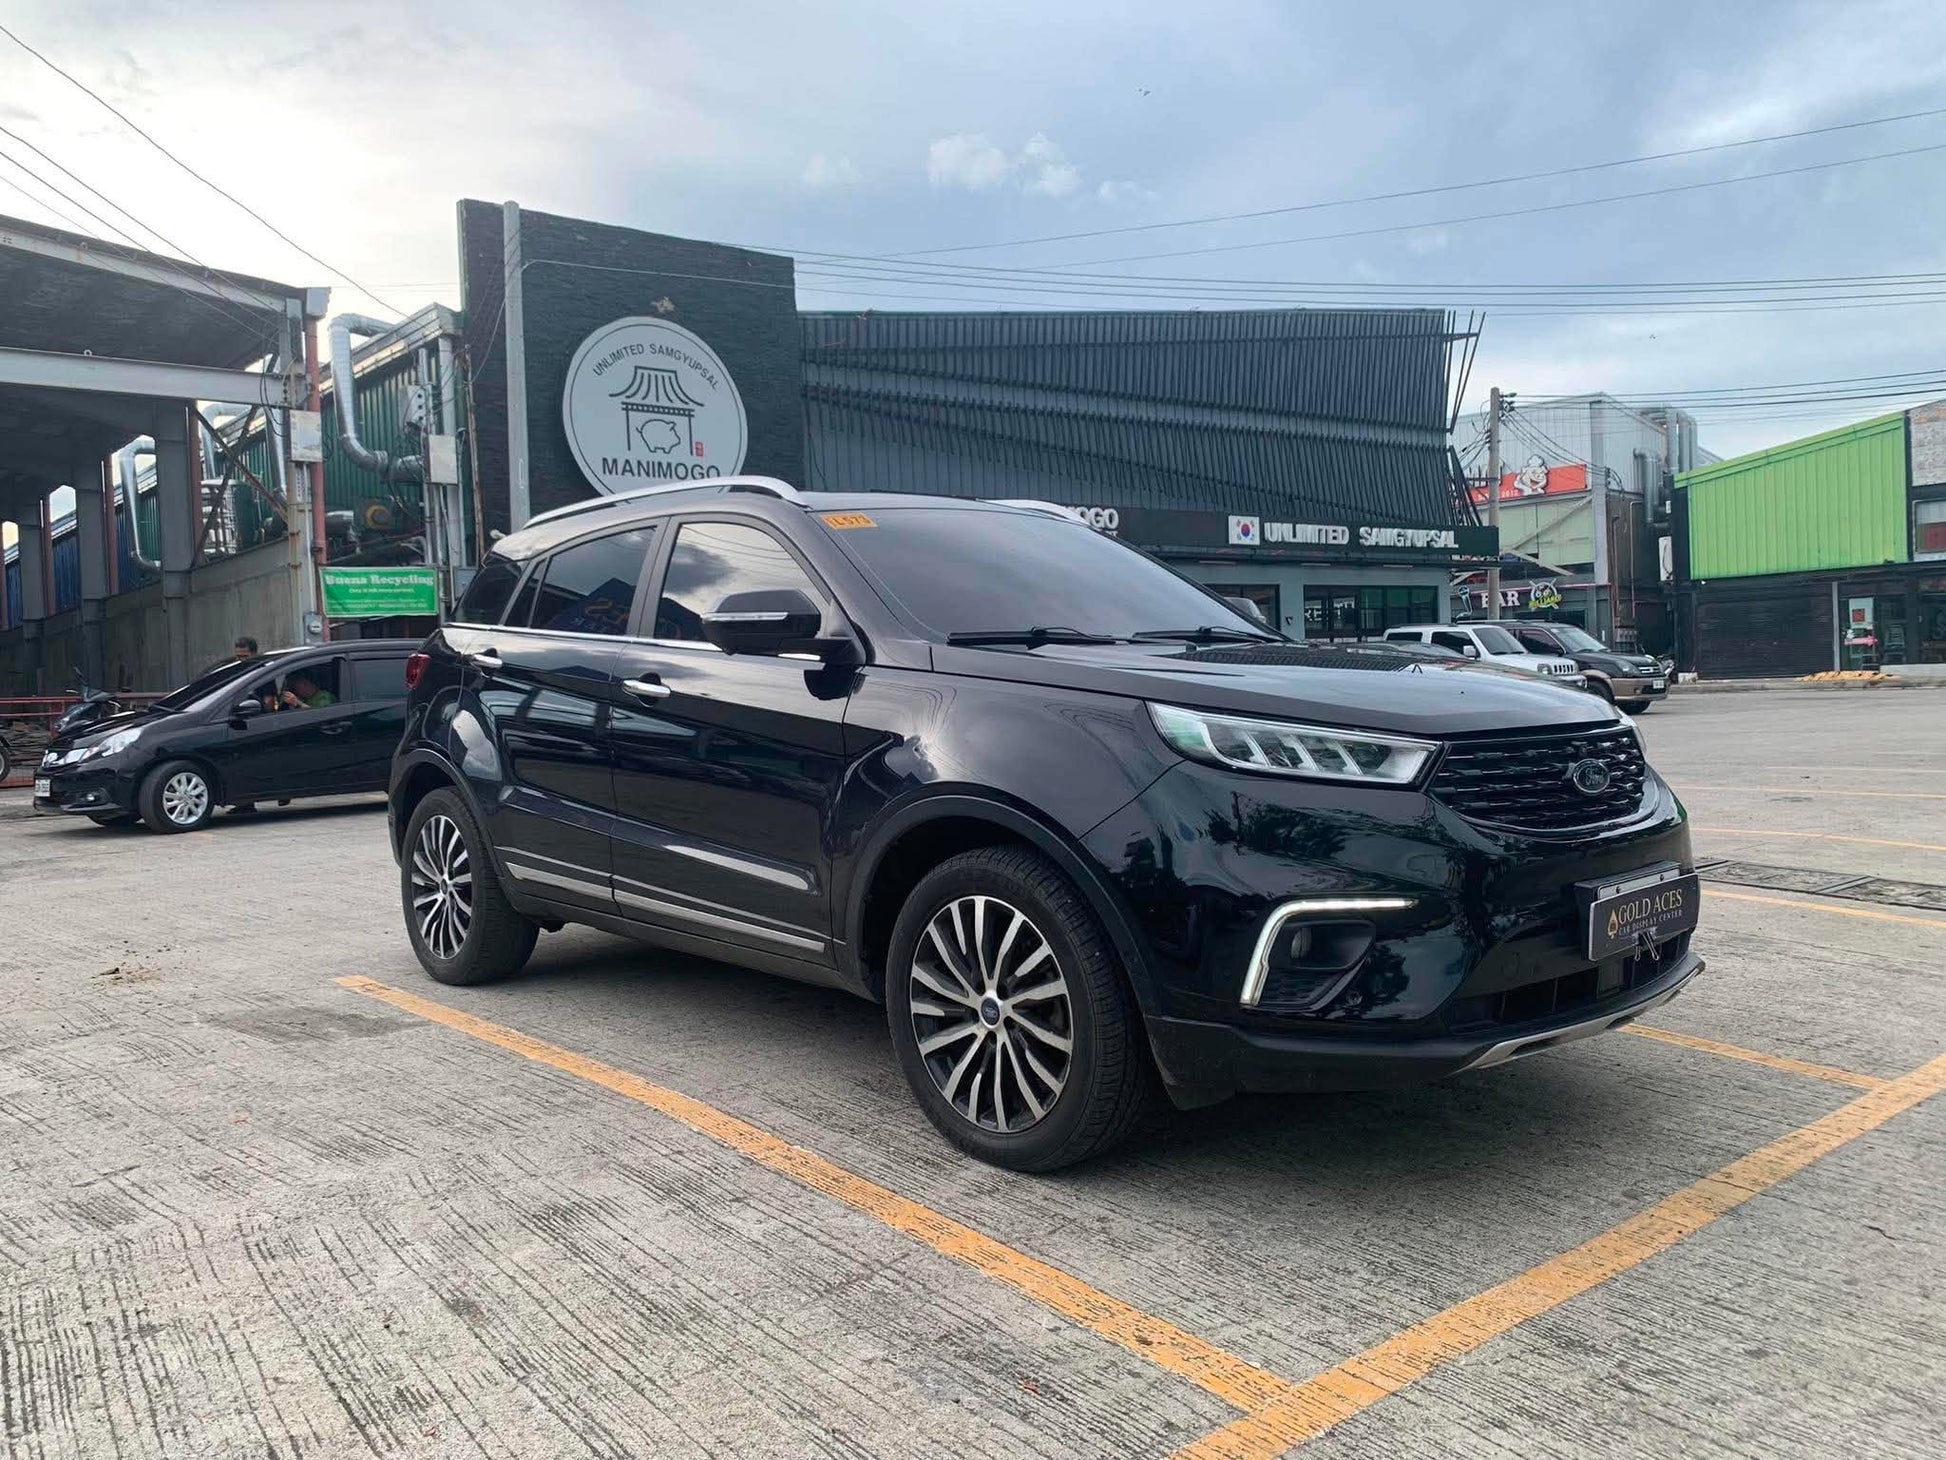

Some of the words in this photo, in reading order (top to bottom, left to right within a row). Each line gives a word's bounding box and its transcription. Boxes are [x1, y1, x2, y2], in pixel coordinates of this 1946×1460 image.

[593, 343, 645, 377] UNLIMITED
[649, 343, 719, 391] SAMGYUPSAL
[602, 457, 720, 480] MANIMOGO
[1066, 506, 1119, 529] OGO
[1264, 522, 1349, 545] UNLIMITED
[1359, 526, 1459, 549] SAMGYUPSAL
[370, 574, 434, 587] Recycling
[1618, 898, 1651, 925] GOLD
[1653, 889, 1683, 914] ACES
